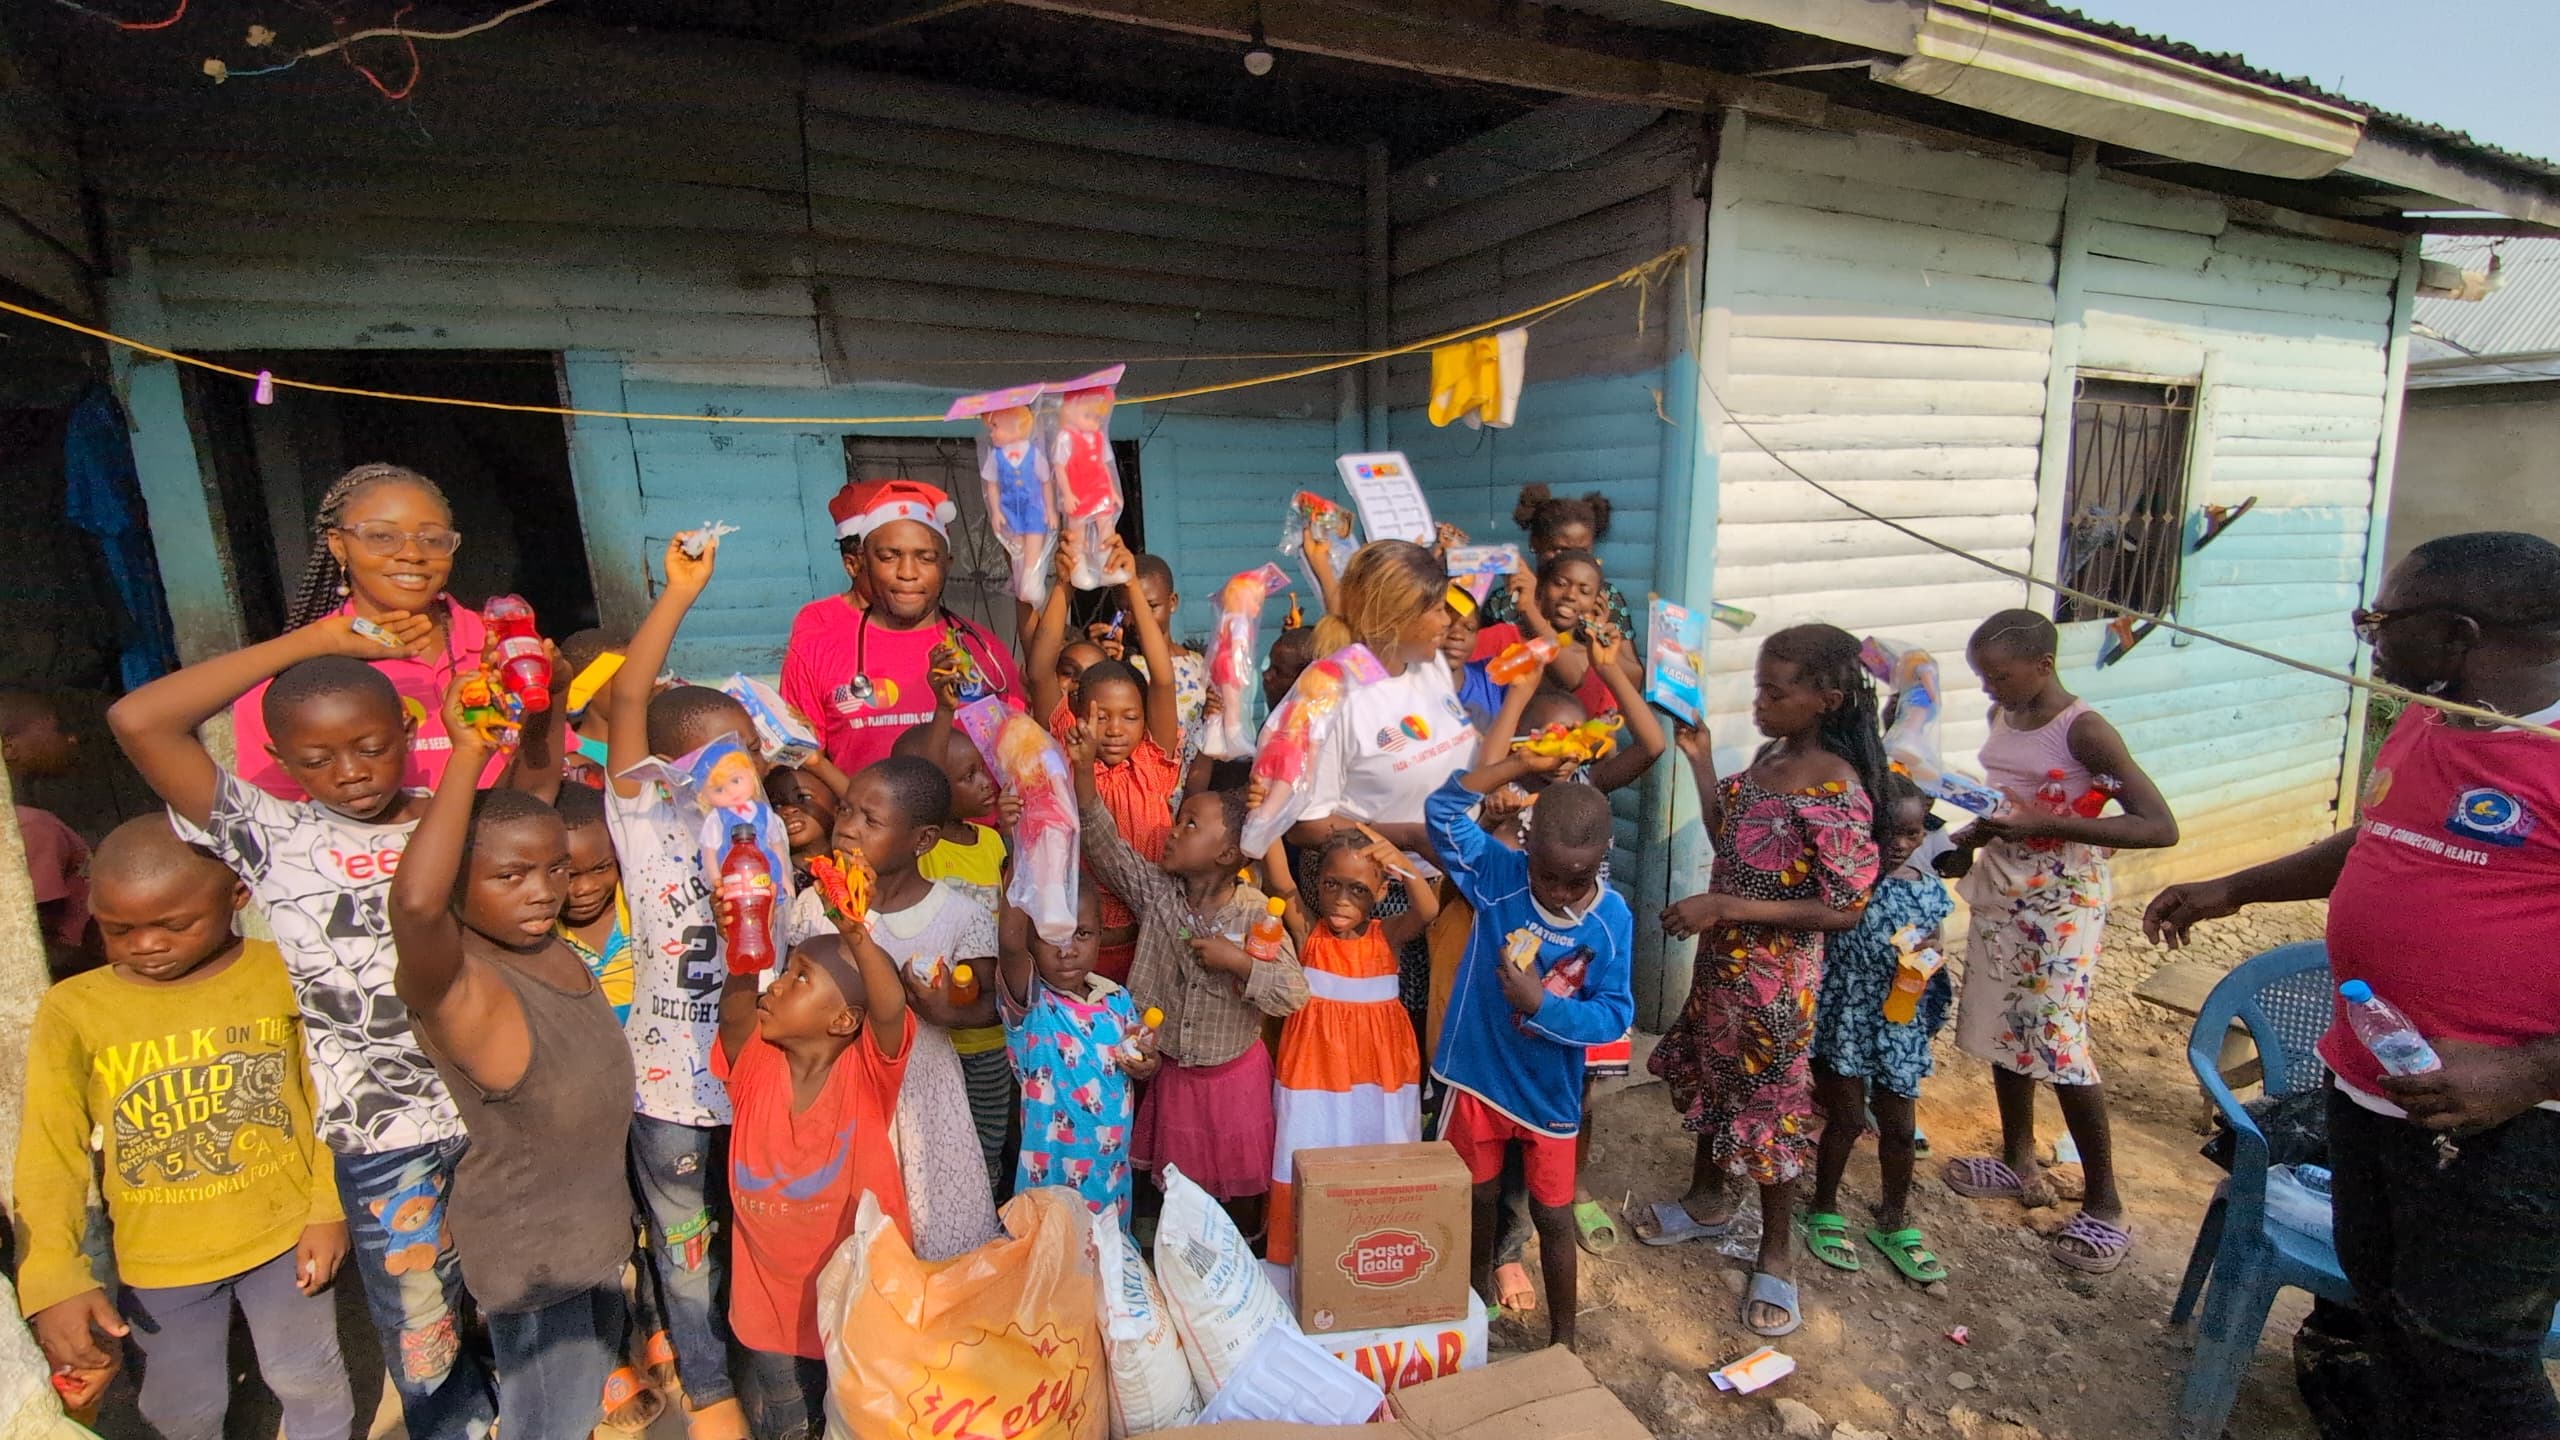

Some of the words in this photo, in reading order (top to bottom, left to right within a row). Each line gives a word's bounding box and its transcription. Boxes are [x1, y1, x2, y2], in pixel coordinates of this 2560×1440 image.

[2390, 828, 2445, 855] CONNECTING
[2444, 844, 2489, 866] HEARTS
[1528, 922, 1575, 947] PATRICK
[93, 1026, 219, 1099] WALK
[226, 1025, 250, 1044] ON
[119, 1063, 233, 1132] WILD
[150, 1091, 228, 1140] SIDE
[165, 1151, 185, 1176] 5
[162, 1174, 250, 1205] NATIONAL
